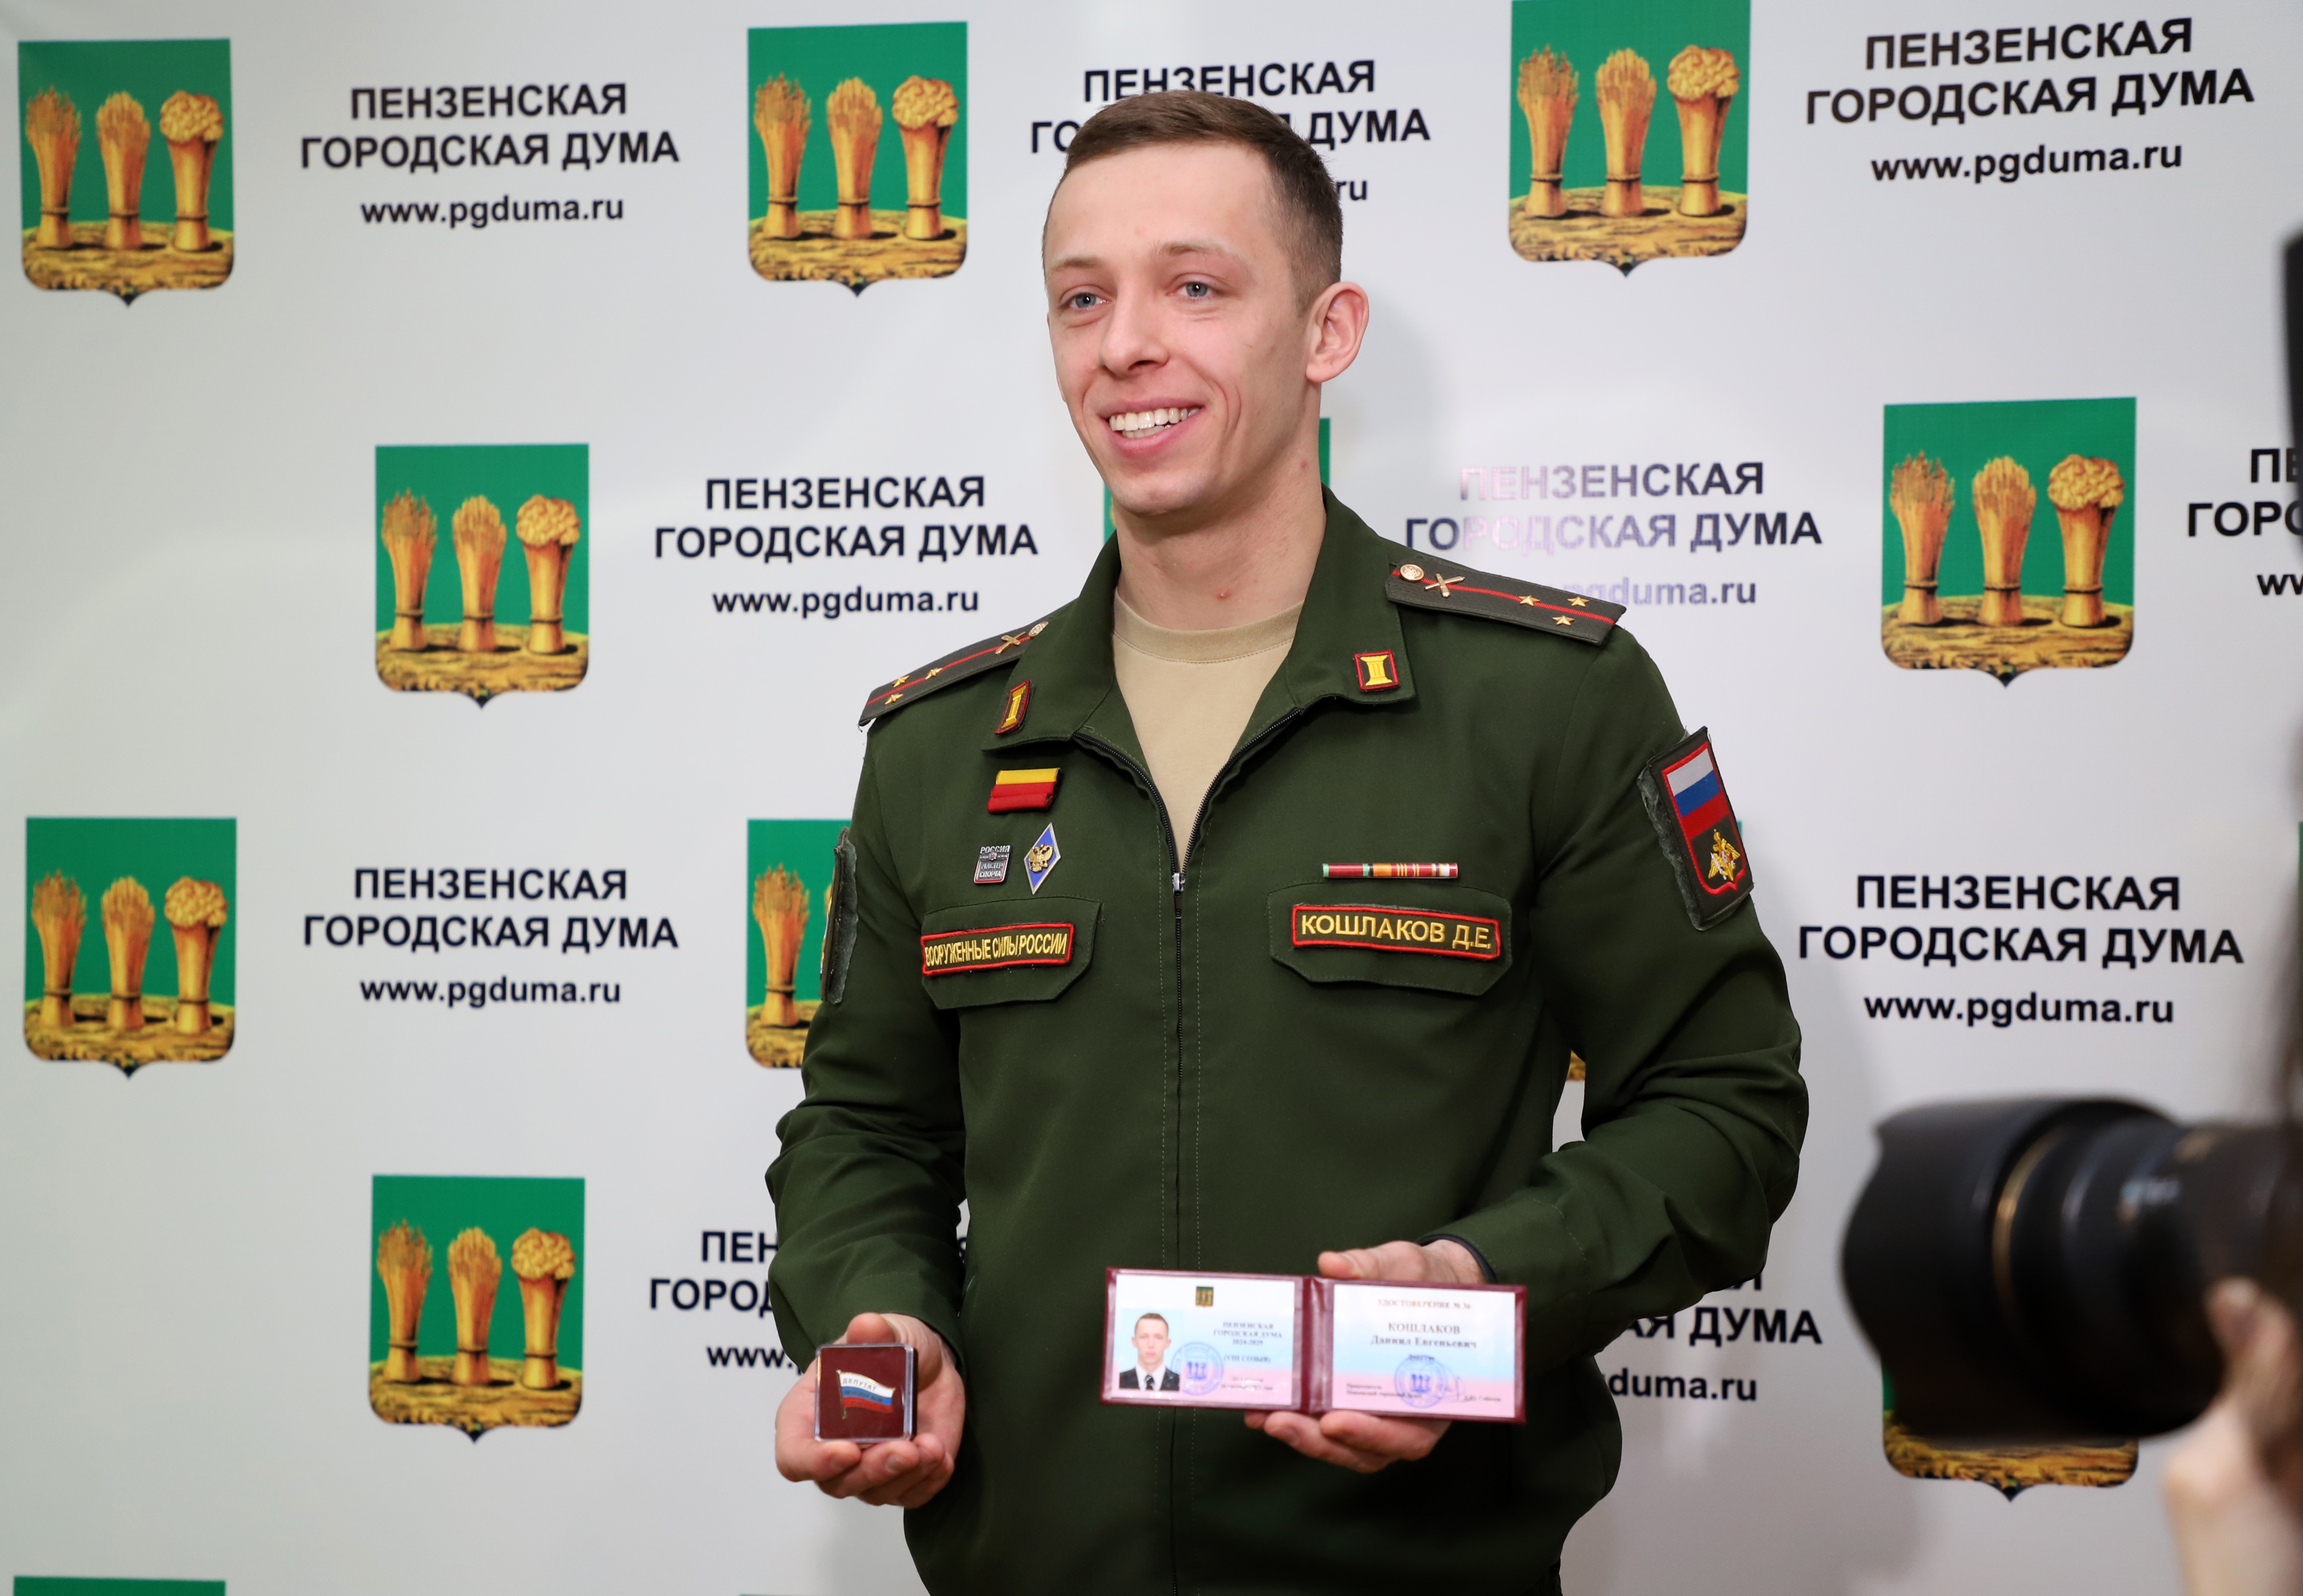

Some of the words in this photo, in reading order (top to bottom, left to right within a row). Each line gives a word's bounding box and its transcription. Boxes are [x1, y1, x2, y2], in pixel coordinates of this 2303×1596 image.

[1866, 17, 2193, 70] ПЕНЗЕНСКАЯ
[1084, 59, 1375, 102] ПЕНЗЕНСКАЯ
[1807, 76, 2097, 125] ГОРОДСКАЯ
[2111, 68, 2255, 117] ДУМА
[351, 83, 626, 119] ПЕНЗЕНСКАЯ
[1309, 108, 1431, 151] ДУМА
[301, 133, 549, 173] ГОРОДСКАЯ
[561, 131, 680, 171] ДУМА
[1871, 145, 2182, 184] www.pgduma.ru
[361, 195, 623, 229] www.pgduma.ru
[706, 476, 984, 509] ПЕНЗЕНСКАЯ
[1460, 462, 1764, 501] ПЕНЗЕНСКАЯ
[656, 526, 904, 564] ГОРОДСКАЯ
[918, 524, 1039, 563] ДУМА
[1406, 513, 1677, 554] ГОРОДСКАЯ
[1690, 512, 1822, 552] ДУМА
[712, 586, 978, 619] www.pgduma.ru
[980, 845, 1010, 854] РОССИЯ
[354, 868, 627, 900] ПЕНЗЕНСКАЯ
[1857, 875, 2180, 911] ПЕНЗЕНСКАЯ
[304, 915, 549, 953] ГОРОДСКАЯ
[561, 917, 678, 954] ДУМА
[924, 939, 992, 967] ВООРУЖЕННЫЕ
[992, 935, 1018, 958] СИЛЫ
[1018, 933, 1067, 956] РОССИИ
[1301, 915, 1446, 943] КОШЛАКОВ
[1452, 925, 1492, 950] Д.Е.
[1799, 926, 2087, 967] ГОРОДСКАЯ
[2102, 928, 2244, 970] ДУМА
[360, 976, 620, 1009] www.pgduma.ru
[1863, 992, 2174, 1028] www.pgduma.ru
[1388, 1322, 1460, 1334] КОШЛАКОВ
[1689, 1306, 1823, 1348] ДУМА
[842, 1378, 876, 1391] ДЕПУТАТ
[1608, 1368, 1756, 1401] duma.ru
